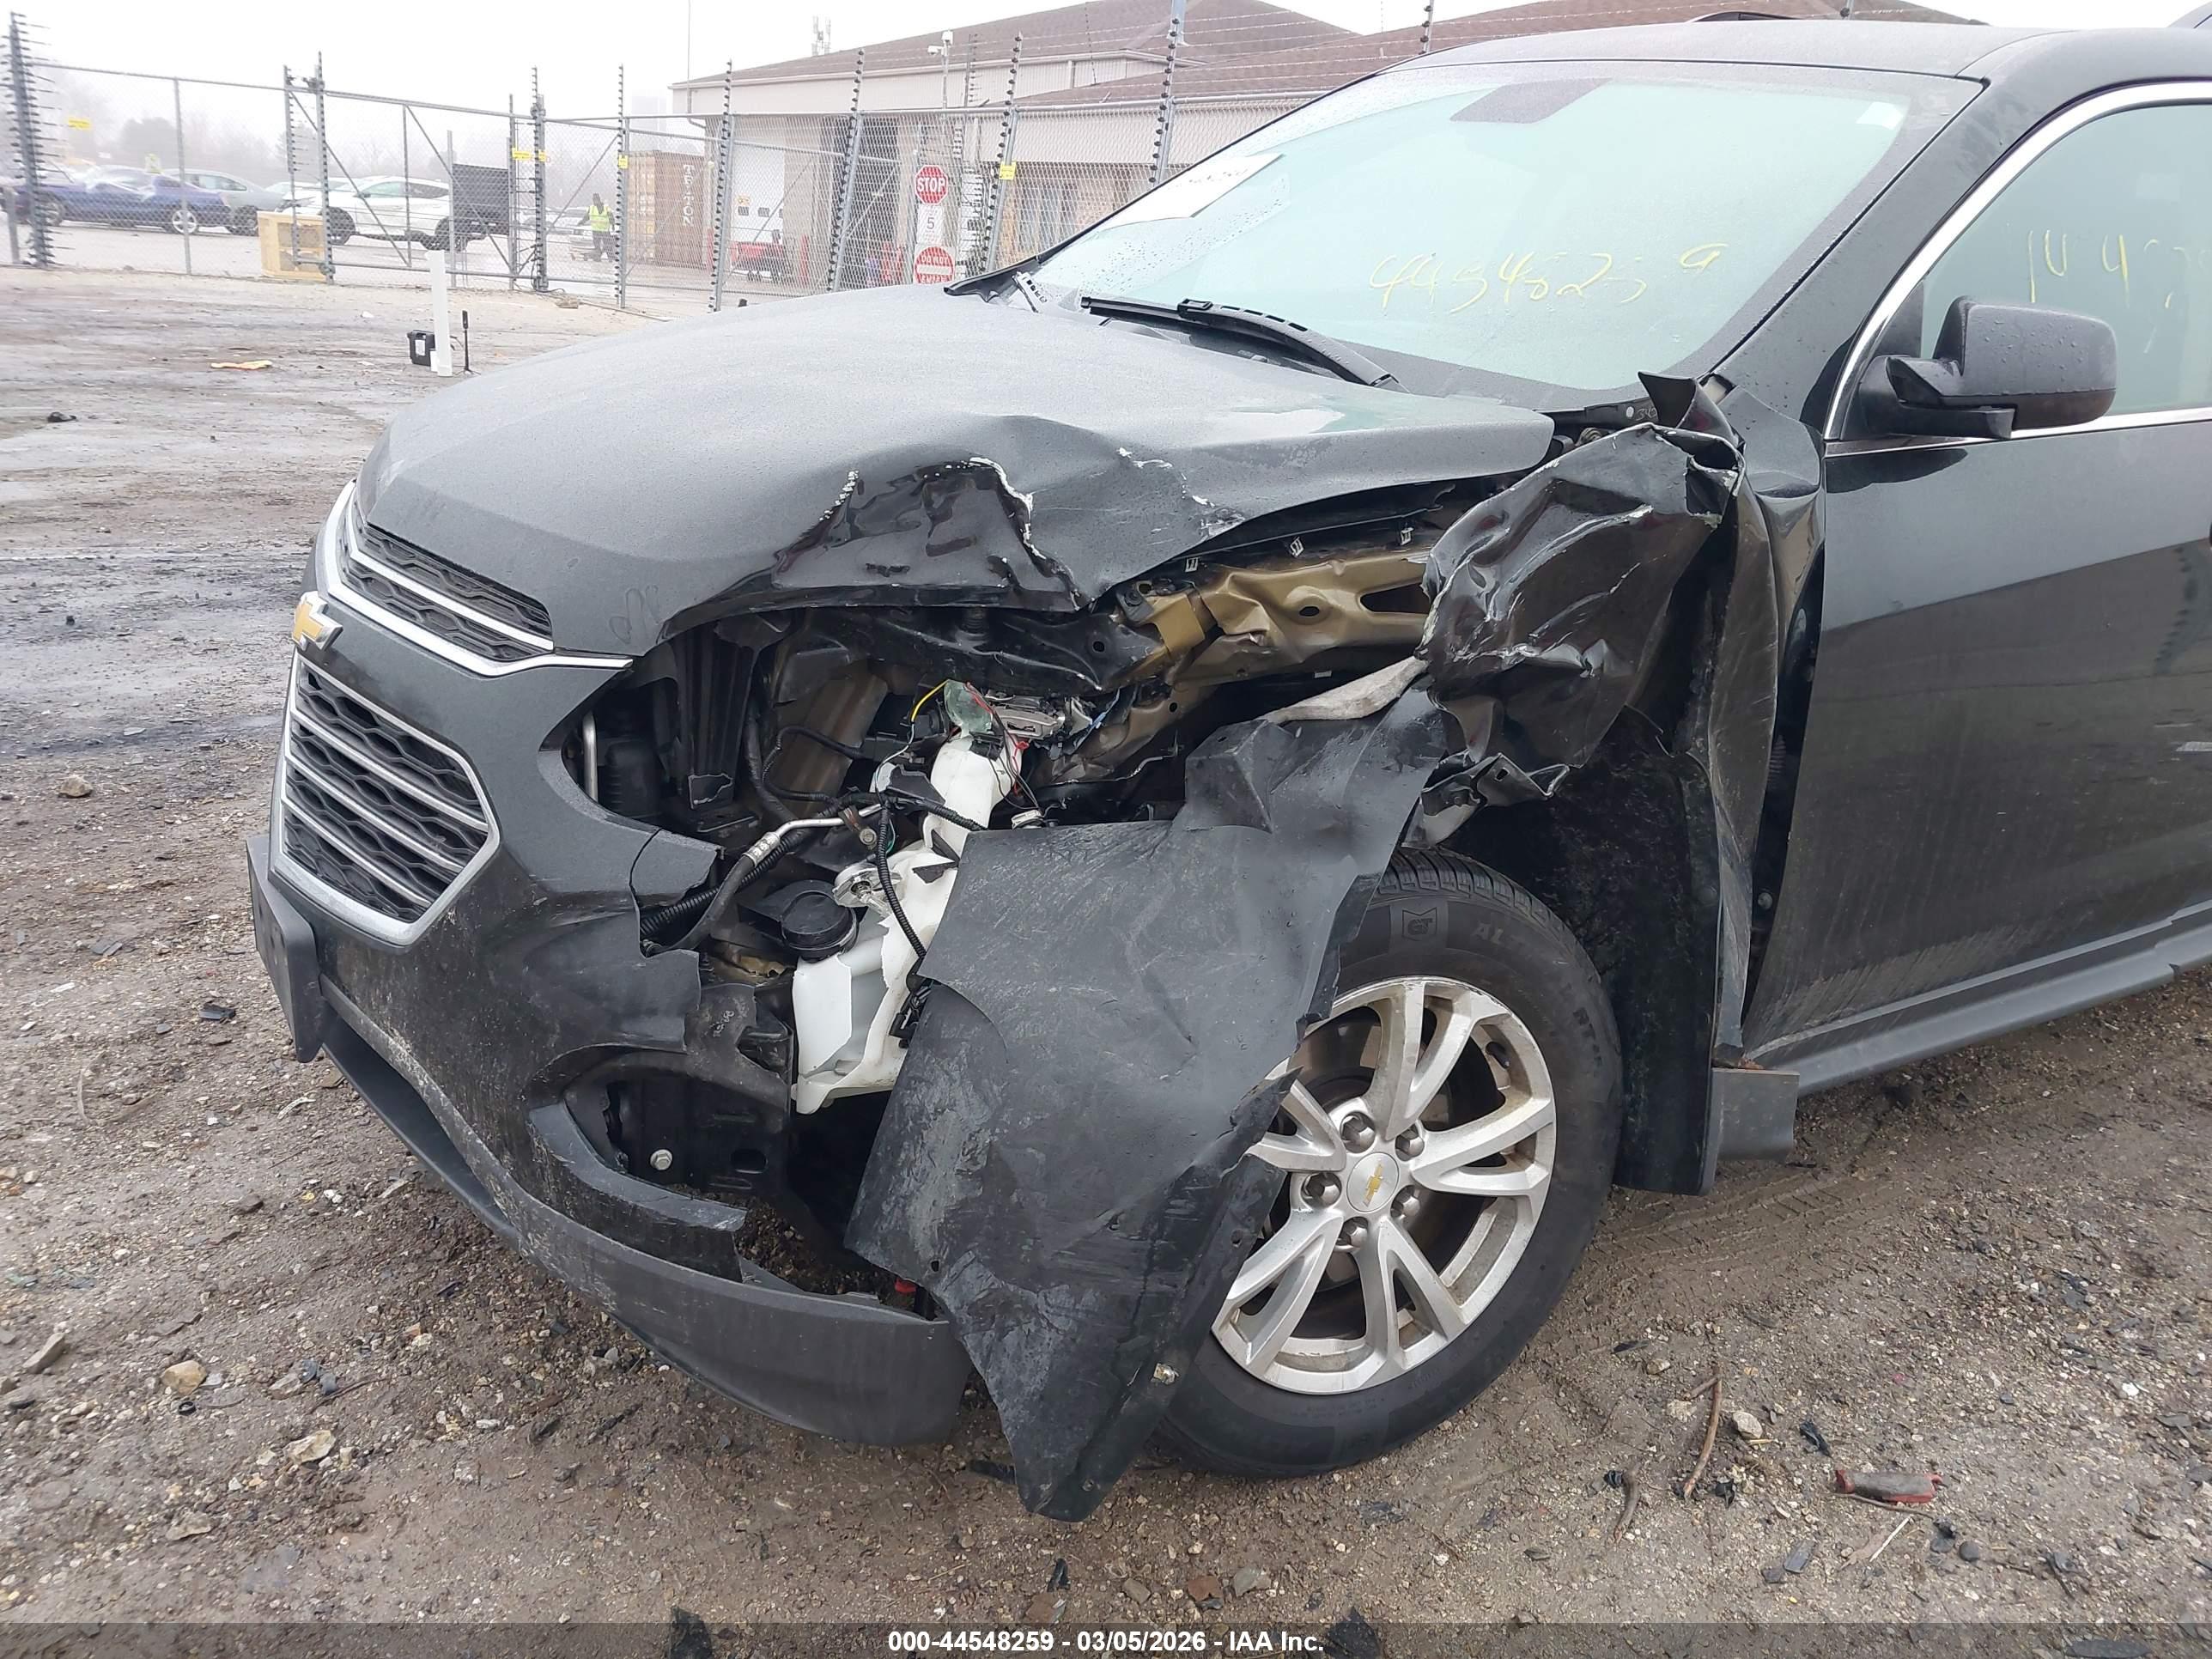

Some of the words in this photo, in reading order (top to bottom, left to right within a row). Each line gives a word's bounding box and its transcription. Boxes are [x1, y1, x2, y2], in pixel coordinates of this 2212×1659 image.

[916, 177, 945, 192] STOP
[927, 216, 935, 230] 5
[921, 255, 932, 264] DO
[933, 256, 949, 265] NOT
